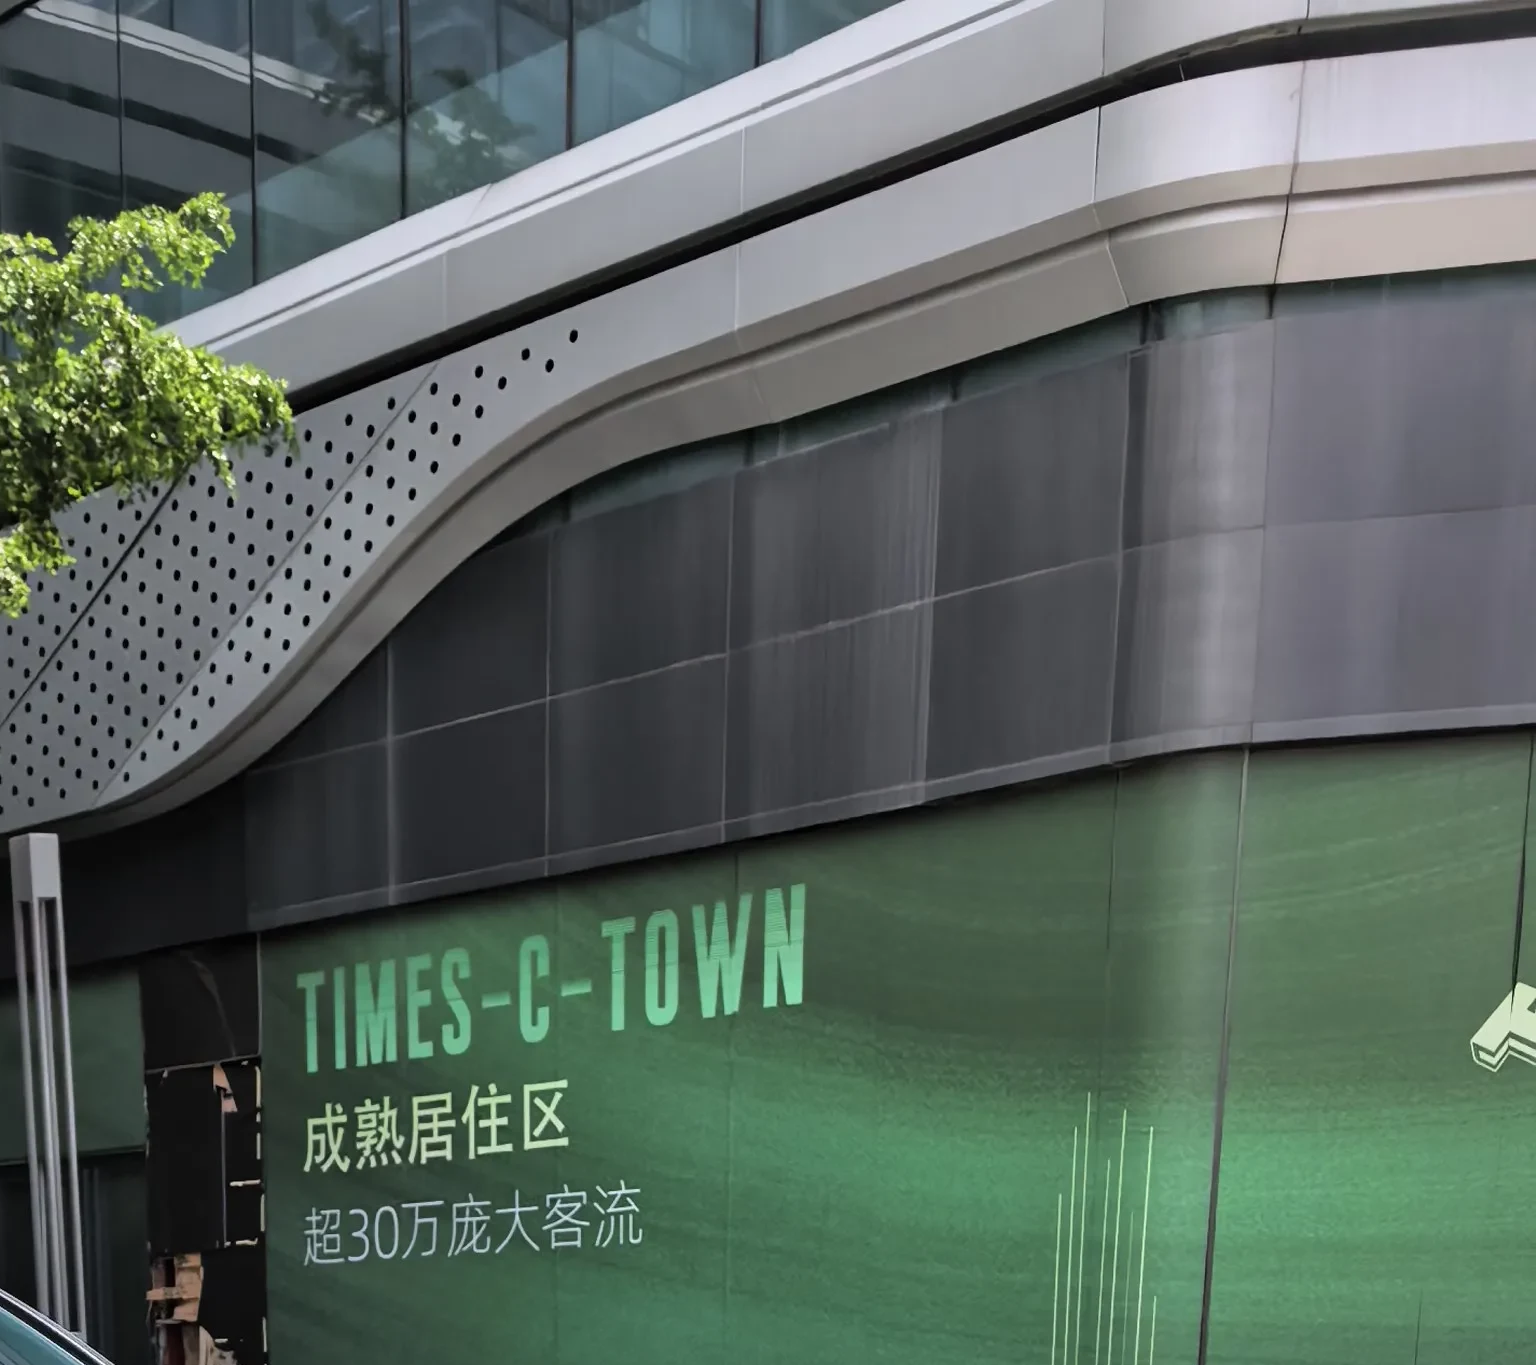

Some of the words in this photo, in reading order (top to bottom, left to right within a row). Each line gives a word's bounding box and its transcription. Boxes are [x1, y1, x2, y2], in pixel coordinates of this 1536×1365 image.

[296, 883, 806, 1073] TIMES-C-TOWN
[303, 1079, 569, 1173] 成熟居住区
[303, 1179, 643, 1267] 超30万庞大客流
